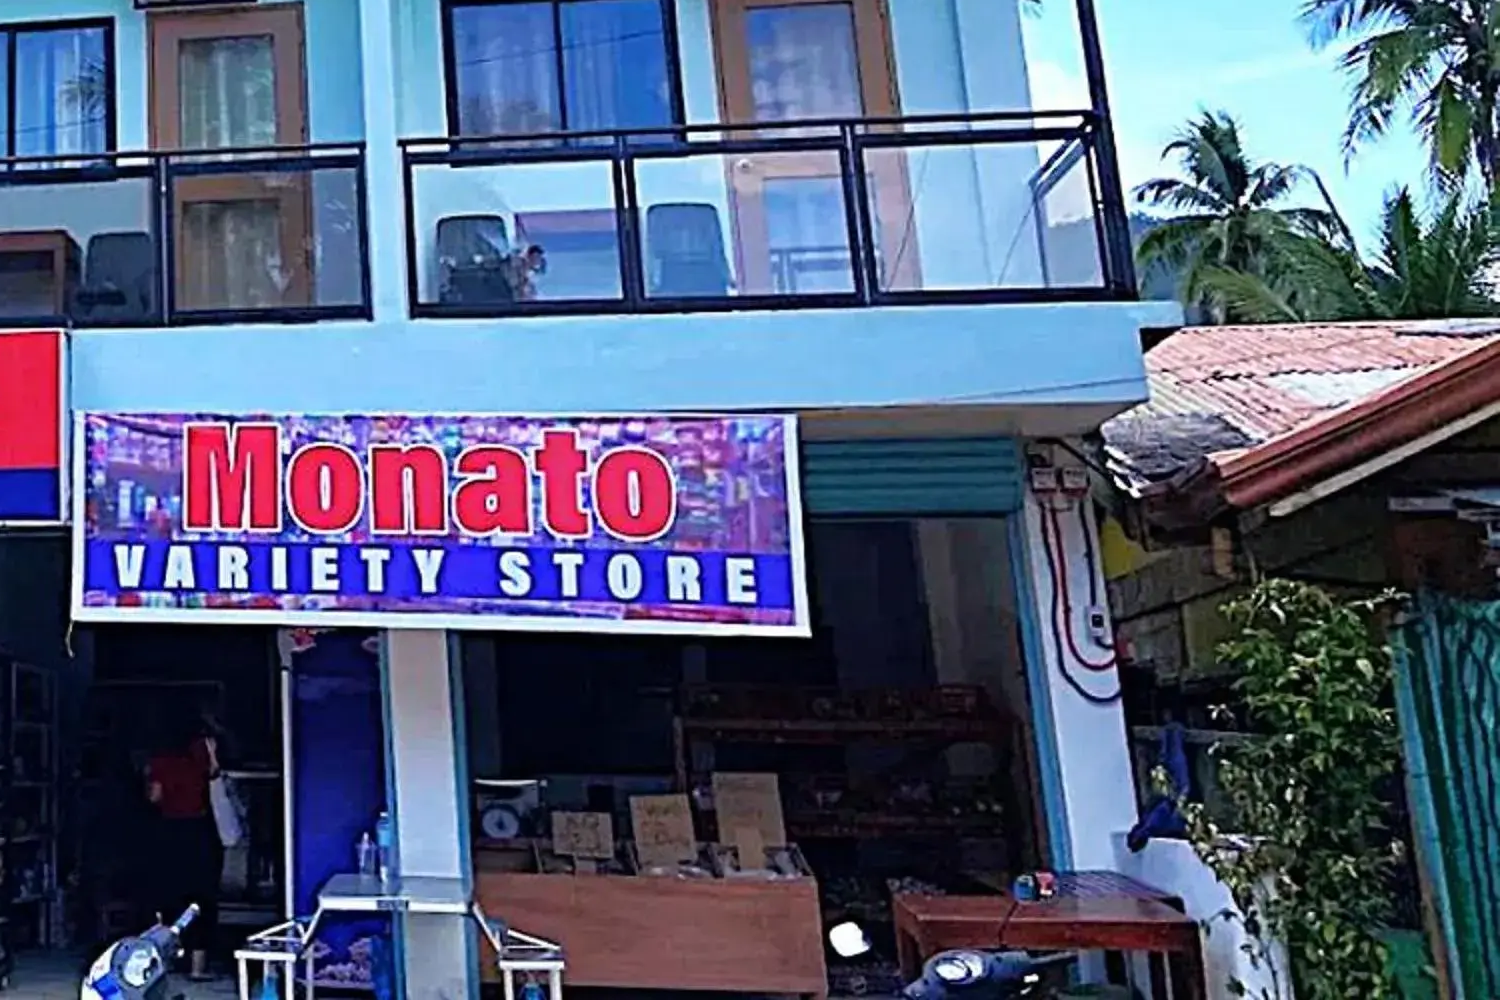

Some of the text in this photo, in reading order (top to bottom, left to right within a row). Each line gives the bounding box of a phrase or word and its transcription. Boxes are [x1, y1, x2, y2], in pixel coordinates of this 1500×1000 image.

[183, 422, 676, 541] Monato
[114, 543, 758, 603] VARIETY STORE
